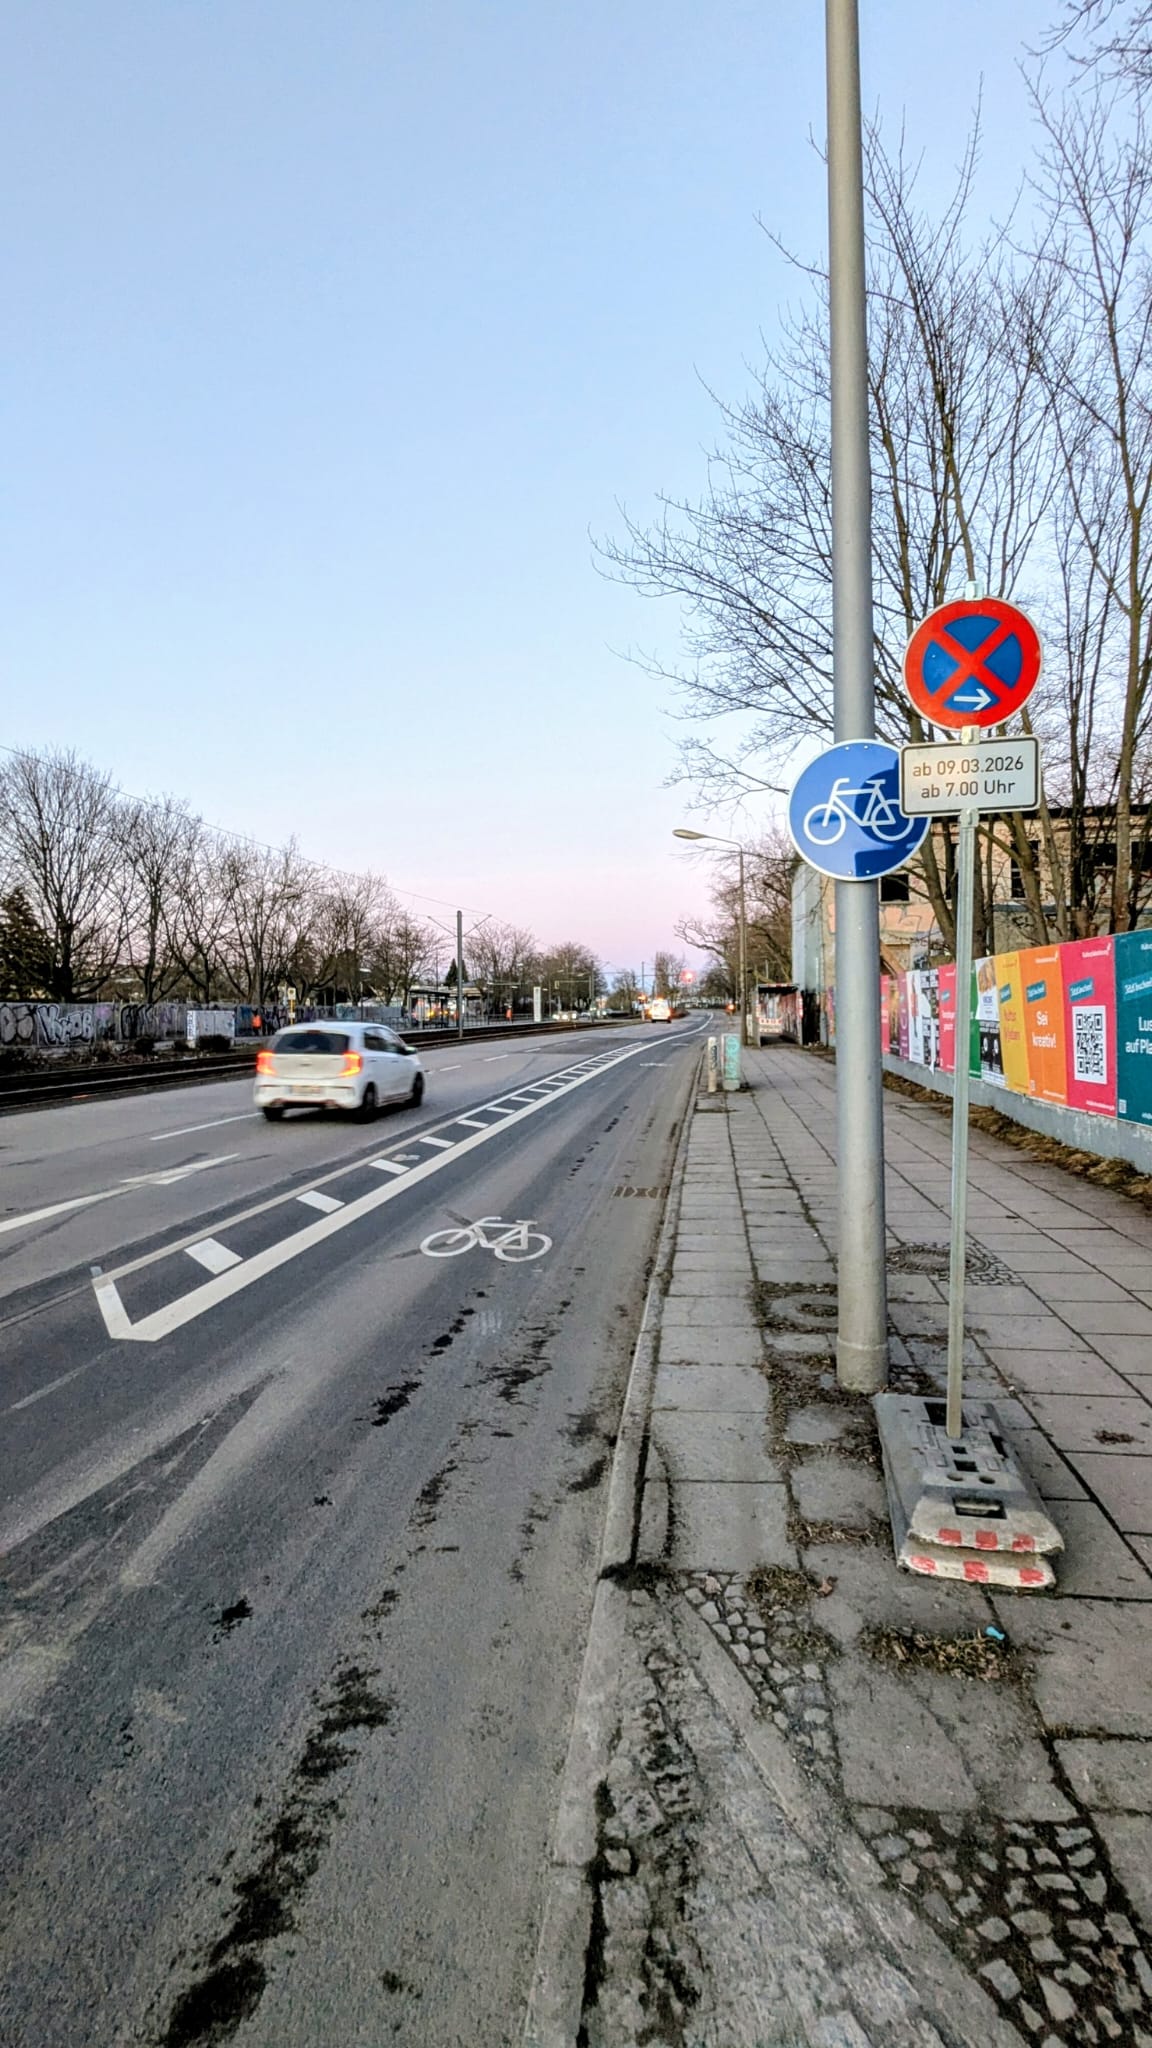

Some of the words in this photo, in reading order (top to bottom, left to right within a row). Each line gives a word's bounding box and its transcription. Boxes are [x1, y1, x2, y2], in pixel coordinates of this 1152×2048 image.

[912, 762, 931, 777] ab
[937, 755, 1024, 776] 09.03.2026
[921, 784, 940, 799] ab
[946, 781, 979, 797] 7.00
[984, 779, 1016, 795] Uhr
[1035, 1010, 1049, 1026] Sei
[1125, 1037, 1139, 1053] auf
